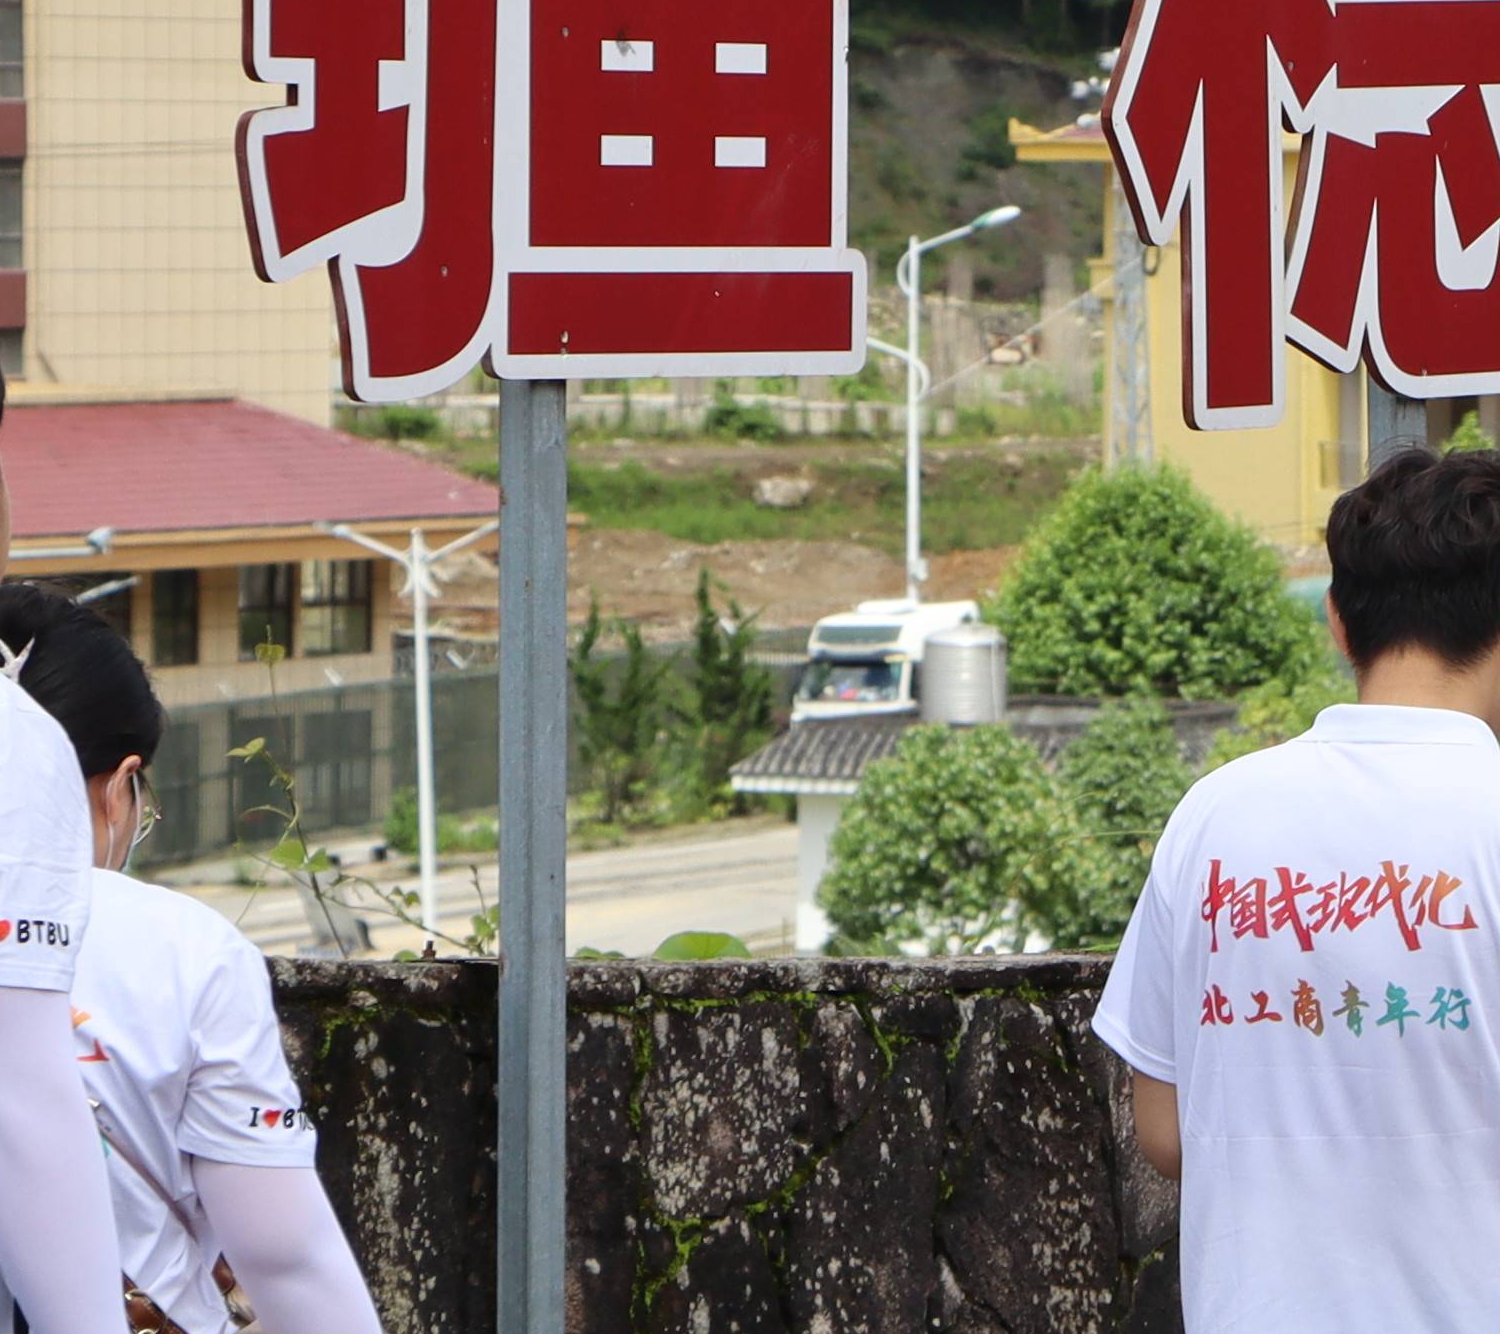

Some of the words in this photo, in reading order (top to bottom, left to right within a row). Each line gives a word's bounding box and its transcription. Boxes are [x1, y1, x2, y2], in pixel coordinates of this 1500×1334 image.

[17, 919, 70, 946] BTBU
[1202, 859, 1479, 953] 中国式现代化
[1200, 978, 1472, 1038] 北工商青年行
